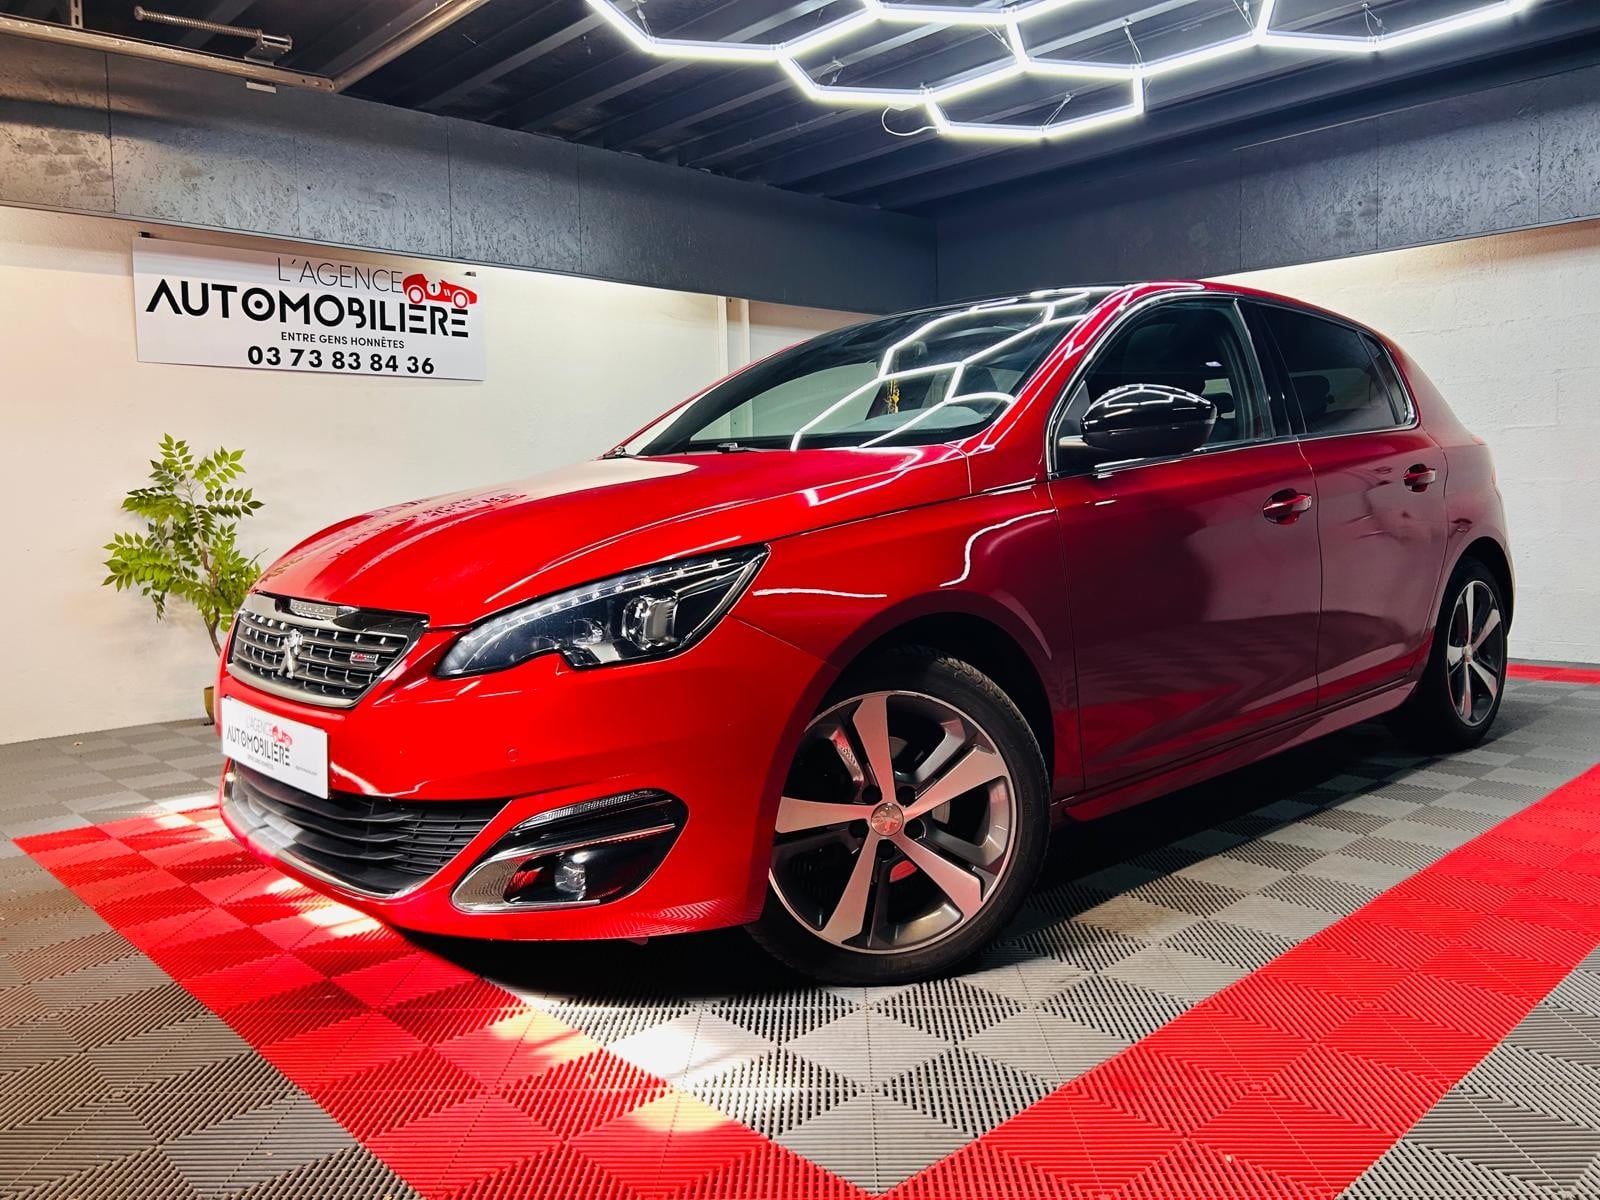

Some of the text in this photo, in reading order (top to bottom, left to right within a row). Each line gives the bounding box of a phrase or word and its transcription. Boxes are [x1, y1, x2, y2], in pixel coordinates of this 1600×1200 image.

[277, 257, 403, 293] L'AGENCE
[281, 331, 405, 349] ENTRE GENS HONNÊTES
[247, 345, 434, 375] 03 73 83 84 36
